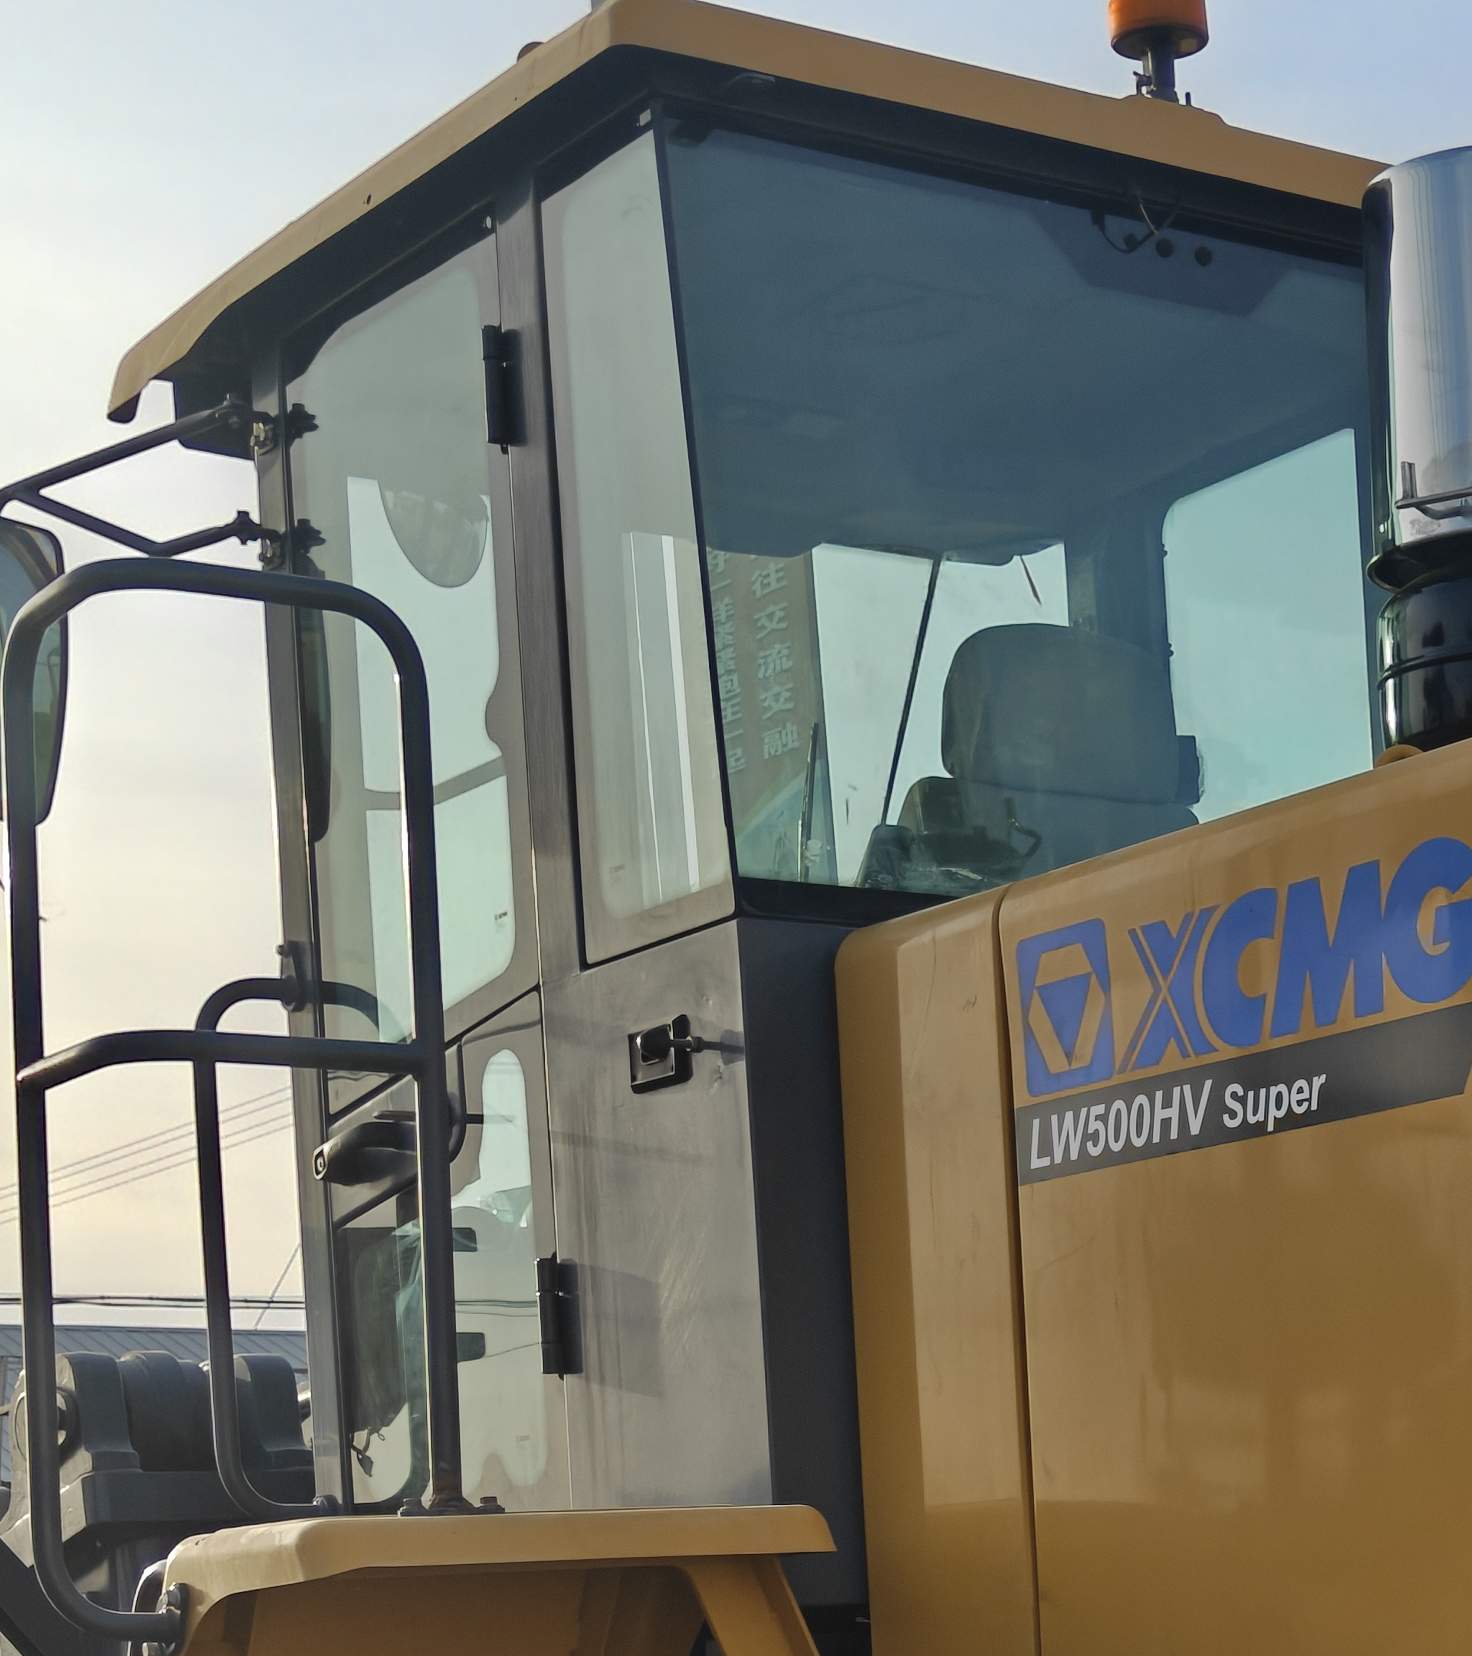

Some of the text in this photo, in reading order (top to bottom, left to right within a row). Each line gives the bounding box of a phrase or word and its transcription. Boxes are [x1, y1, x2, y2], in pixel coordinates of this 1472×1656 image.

[751, 556, 801, 760] 往交流交融
[1029, 1073, 1327, 1171] LW500HV Super
